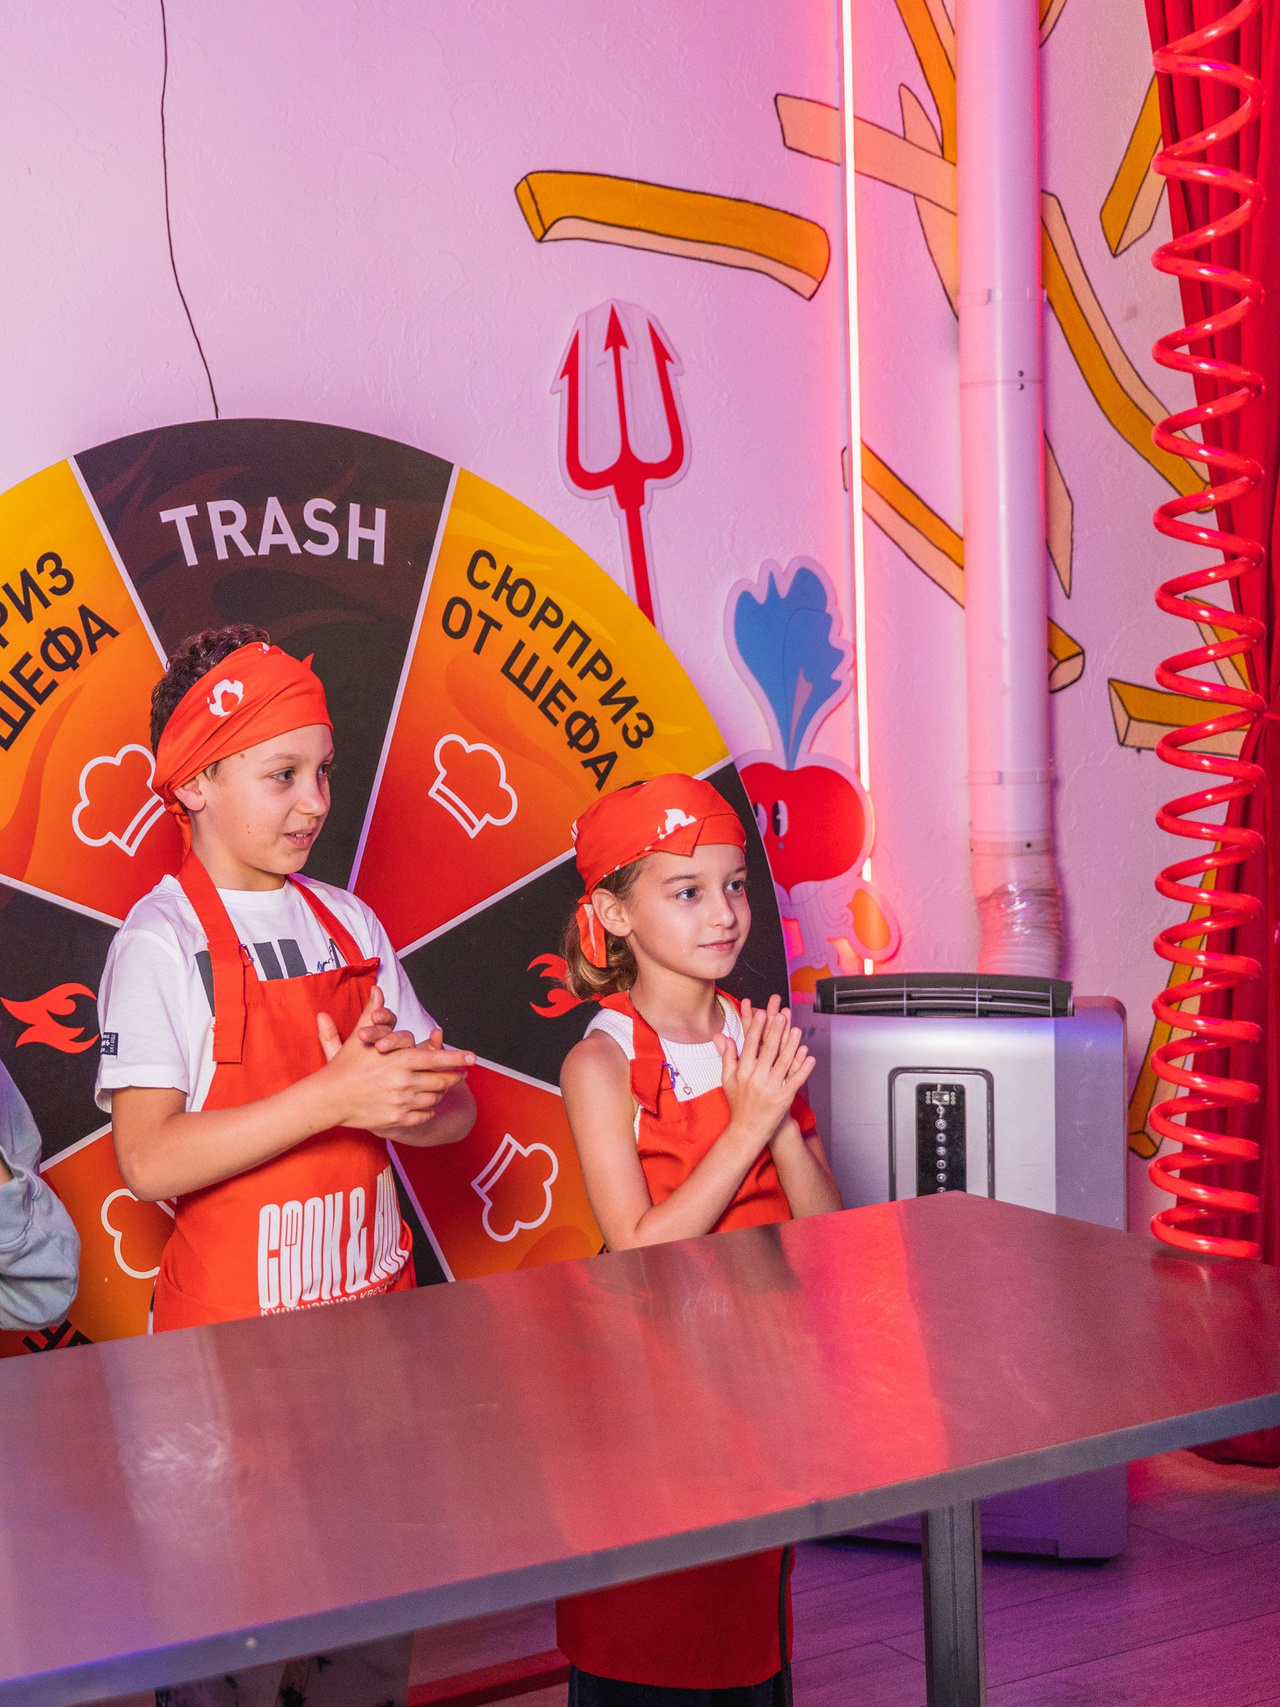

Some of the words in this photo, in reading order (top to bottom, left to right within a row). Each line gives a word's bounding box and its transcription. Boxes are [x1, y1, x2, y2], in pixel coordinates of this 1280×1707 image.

[160, 497, 386, 567] TRASH
[441, 596, 503, 655] ОТ
[500, 639, 618, 792] ШЕФА
[466, 549, 655, 750] СЮРПРИЗ
[257, 1191, 344, 1309] COOK
[345, 1187, 371, 1293] &
